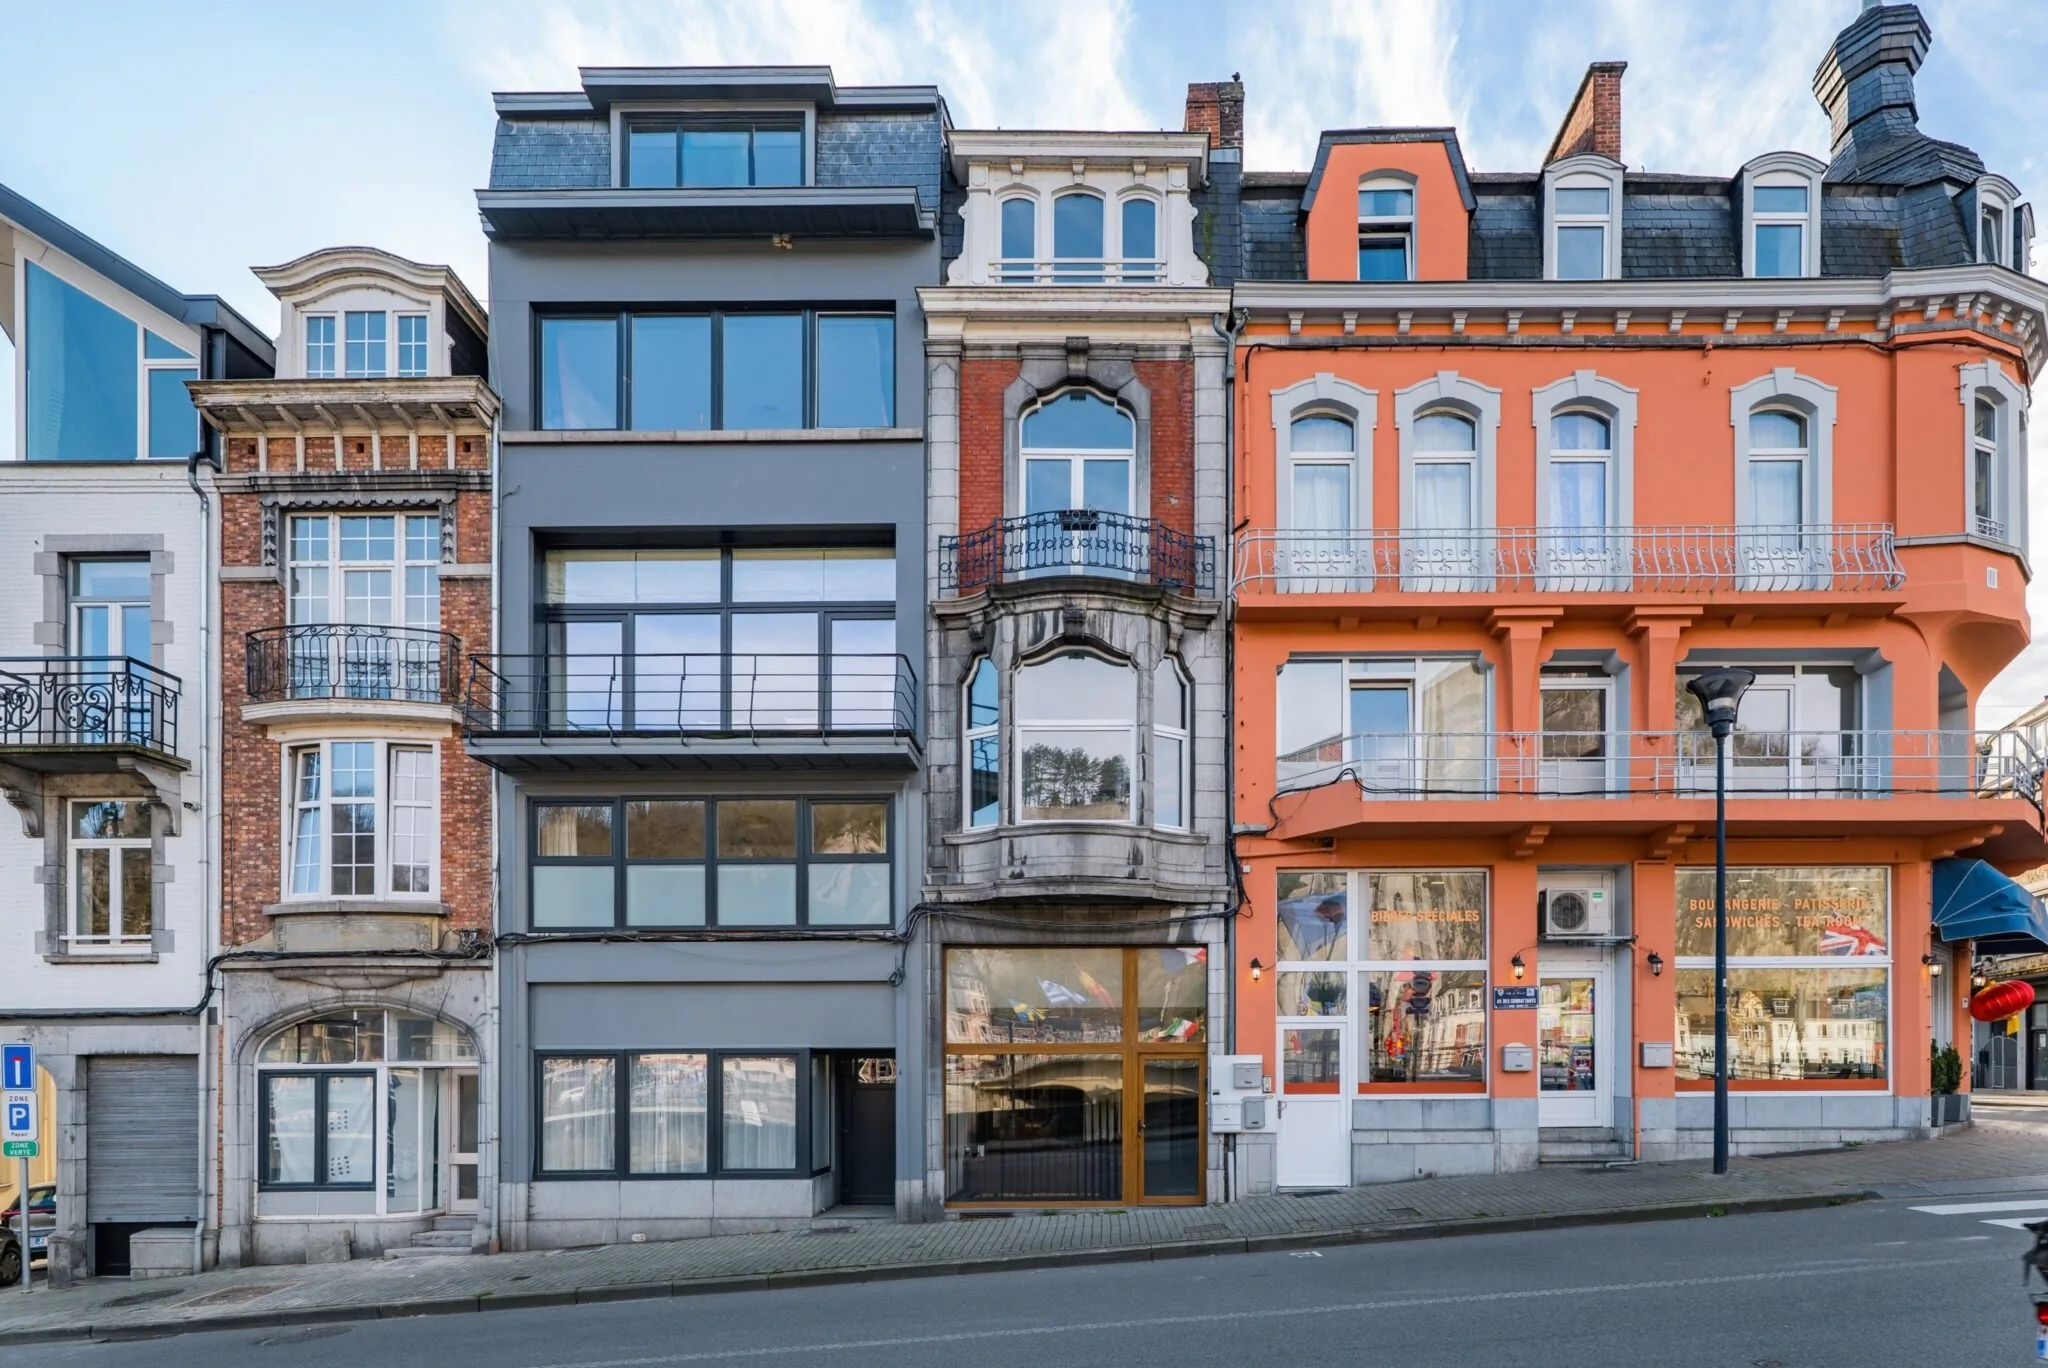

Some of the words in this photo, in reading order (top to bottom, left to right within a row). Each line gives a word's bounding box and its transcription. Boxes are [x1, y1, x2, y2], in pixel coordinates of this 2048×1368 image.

[1689, 898, 1780, 911] BOUANGERIE
[1695, 916, 1780, 928] SAWICHES
[12, 1107, 27, 1127] P
